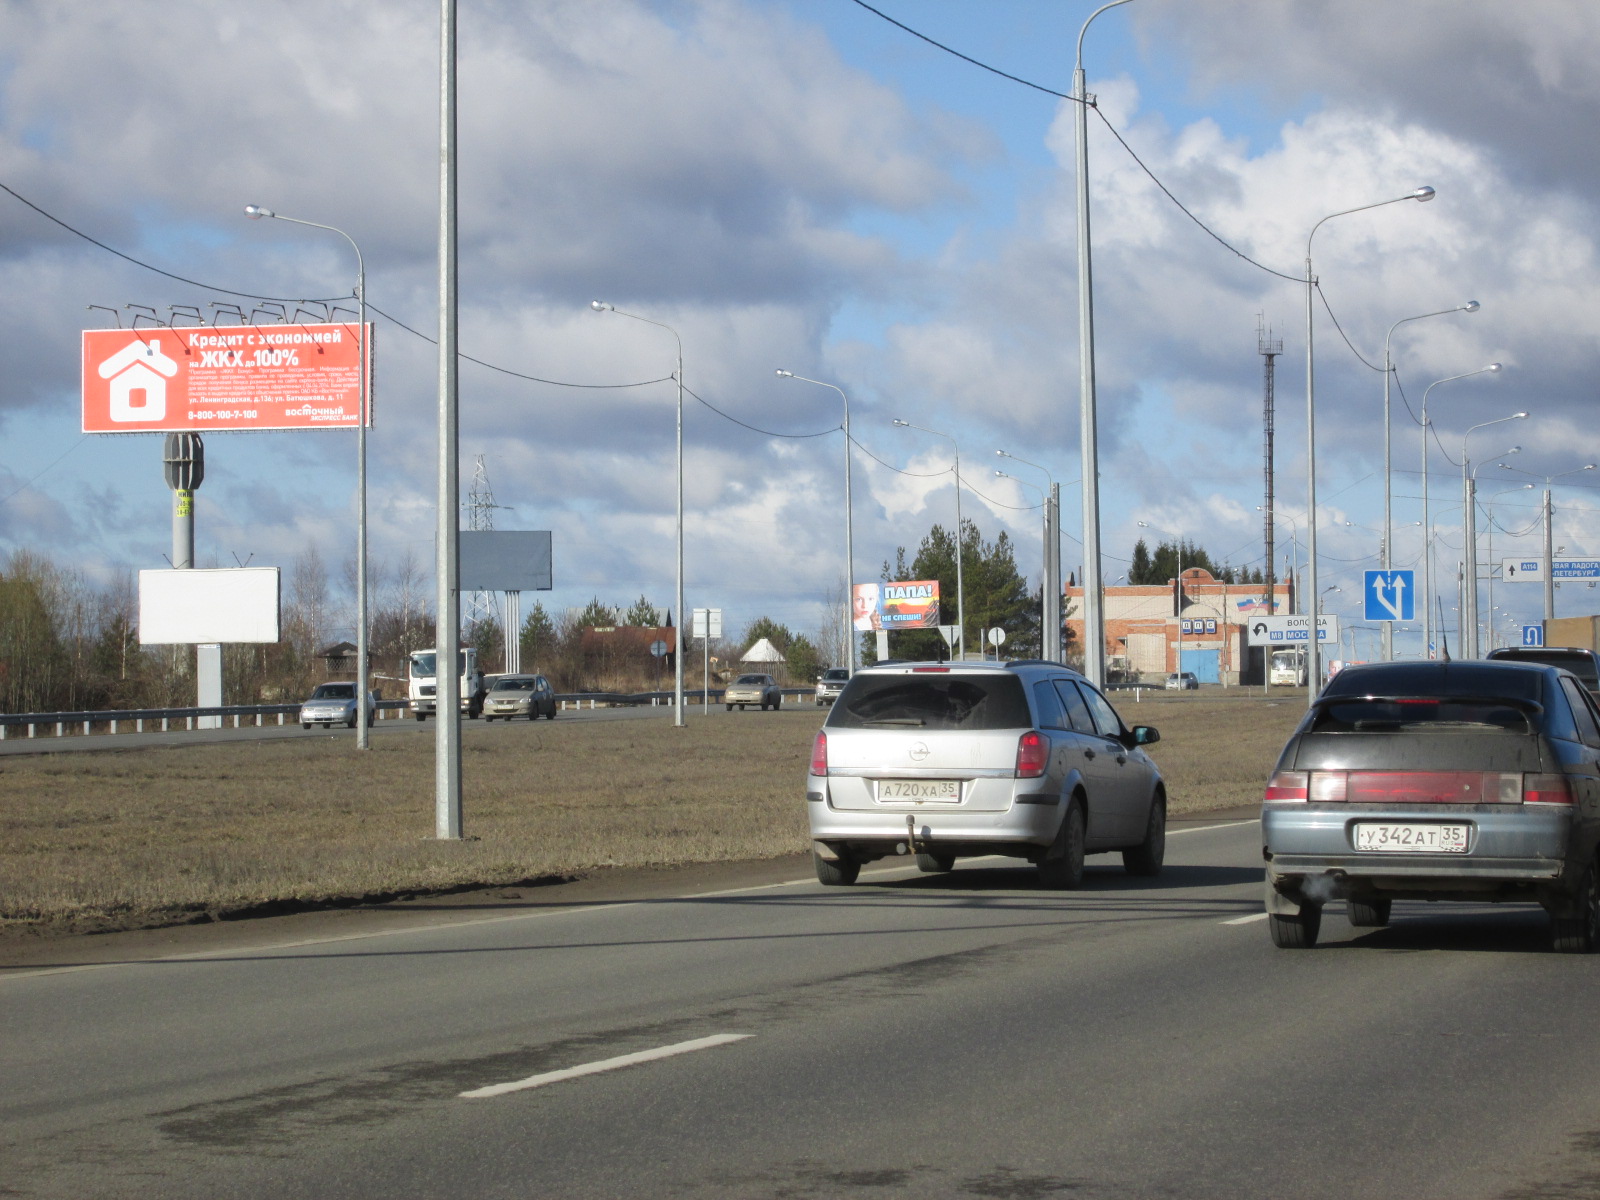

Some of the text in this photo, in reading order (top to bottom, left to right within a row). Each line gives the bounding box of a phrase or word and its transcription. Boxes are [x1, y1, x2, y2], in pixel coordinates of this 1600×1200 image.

[188, 330, 342, 349] Кредит с экономией
[199, 350, 244, 368] ЖКХ
[245, 360, 255, 368] до
[254, 349, 299, 367] 100%
[189, 397, 198, 405] ул.
[188, 410, 258, 420] 8-800-100-7-100
[285, 404, 344, 416] восточный
[1571, 562, 1599, 570] ЛАДОГА
[884, 584, 932, 599] ПАПА!
[893, 613, 922, 621] СПЕШИ!
[1287, 618, 1328, 627] ВОЛОДА
[1287, 631, 1325, 640] МОСА
[941, 783, 955, 793] 35
[1442, 827, 1460, 841] 35
